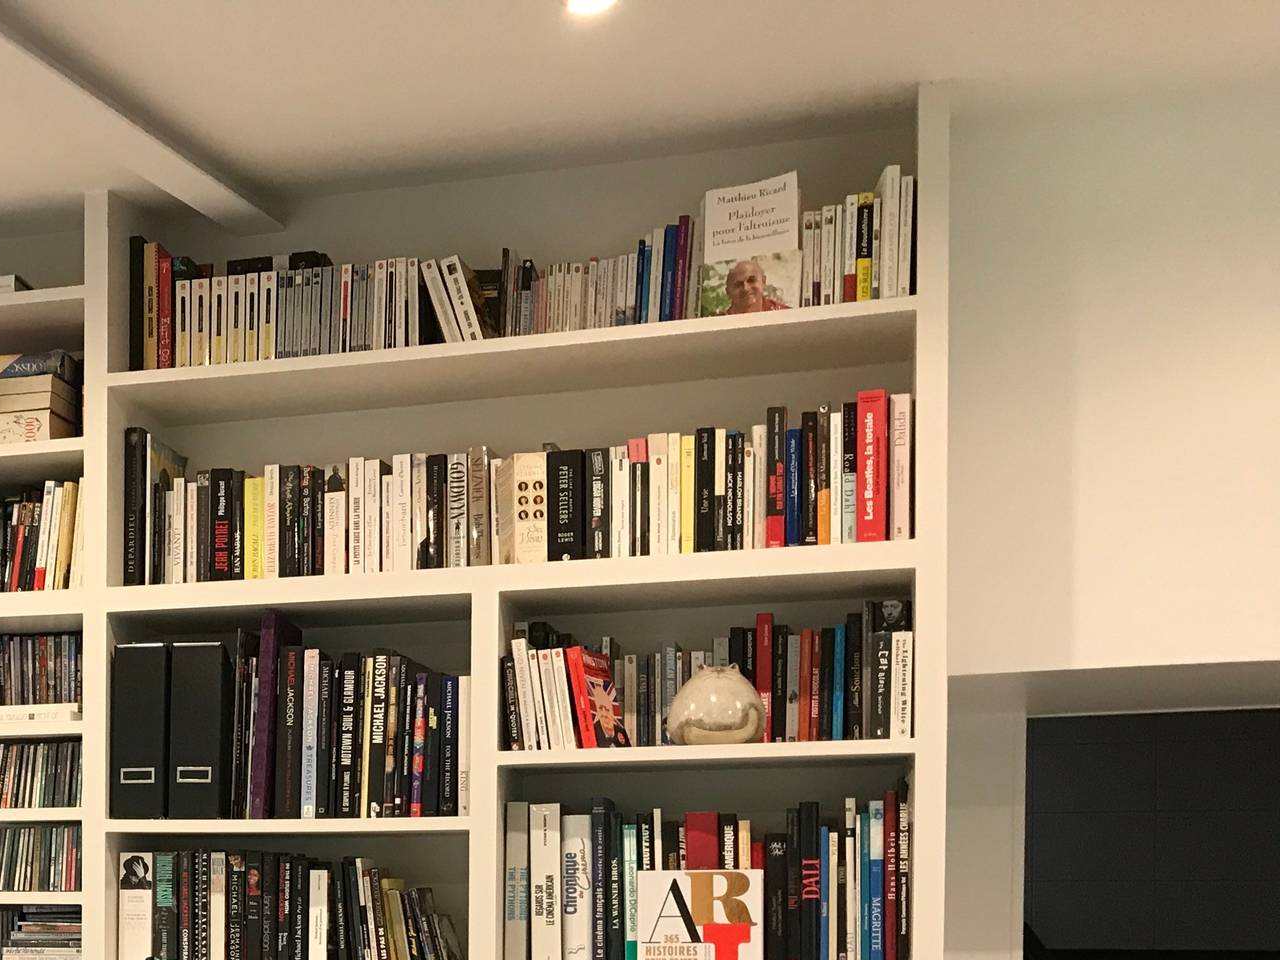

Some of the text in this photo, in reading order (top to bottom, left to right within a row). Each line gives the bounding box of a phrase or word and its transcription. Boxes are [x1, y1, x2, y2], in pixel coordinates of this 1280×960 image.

[717, 182, 786, 206] Matthieu Ricard
[727, 205, 776, 222] Plaidoyer
[712, 217, 791, 239] pour l'altruisme
[895, 411, 907, 447] Dalida
[843, 453, 855, 514] Roald Dahl
[864, 412, 874, 521] Les Beatles, la totale
[448, 461, 465, 520] GOLDWYN
[558, 466, 569, 525] PETER SELLERS
[215, 519, 228, 572] JEAN POIRET
[286, 651, 295, 726] MICHAEL JACKSON
[320, 666, 329, 701] MICHAEL
[343, 669, 355, 704] GLAMOUR
[372, 655, 386, 744] MICHAEL JACKSON
[306, 703, 315, 743] JACKSON
[342, 714, 353, 731] SOUL
[444, 709, 452, 739] JACKSON
[342, 733, 352, 765] MOTOWN
[305, 754, 313, 801] TREASURES
[642, 823, 651, 870] TRUFFAUT
[723, 824, 734, 870] AMÉRIQUE
[899, 801, 909, 873] LES ANNÉES CHARLIE
[564, 852, 579, 914] Chronique
[802, 857, 821, 900] DALI
[887, 831, 896, 900] Hans Holbein
[535, 884, 544, 917] REGARDS SUR
[543, 874, 555, 900] AMÉRICAIN
[610, 856, 619, 929] LA WARNER BROS.
[627, 863, 637, 932] Leonardo DiCaprio
[263, 892, 272, 952] Janet Jackson
[294, 914, 302, 939] Jackson
[543, 900, 555, 919] CINÉMA
[594, 887, 605, 958] Le cinéma français
[871, 897, 881, 951] MAGRITTE
[378, 927, 386, 936] DE
[379, 936, 387, 949] PAS
[645, 945, 698, 957] HISTOIRES
[664, 933, 680, 943] 365
[380, 948, 388, 960] LES
